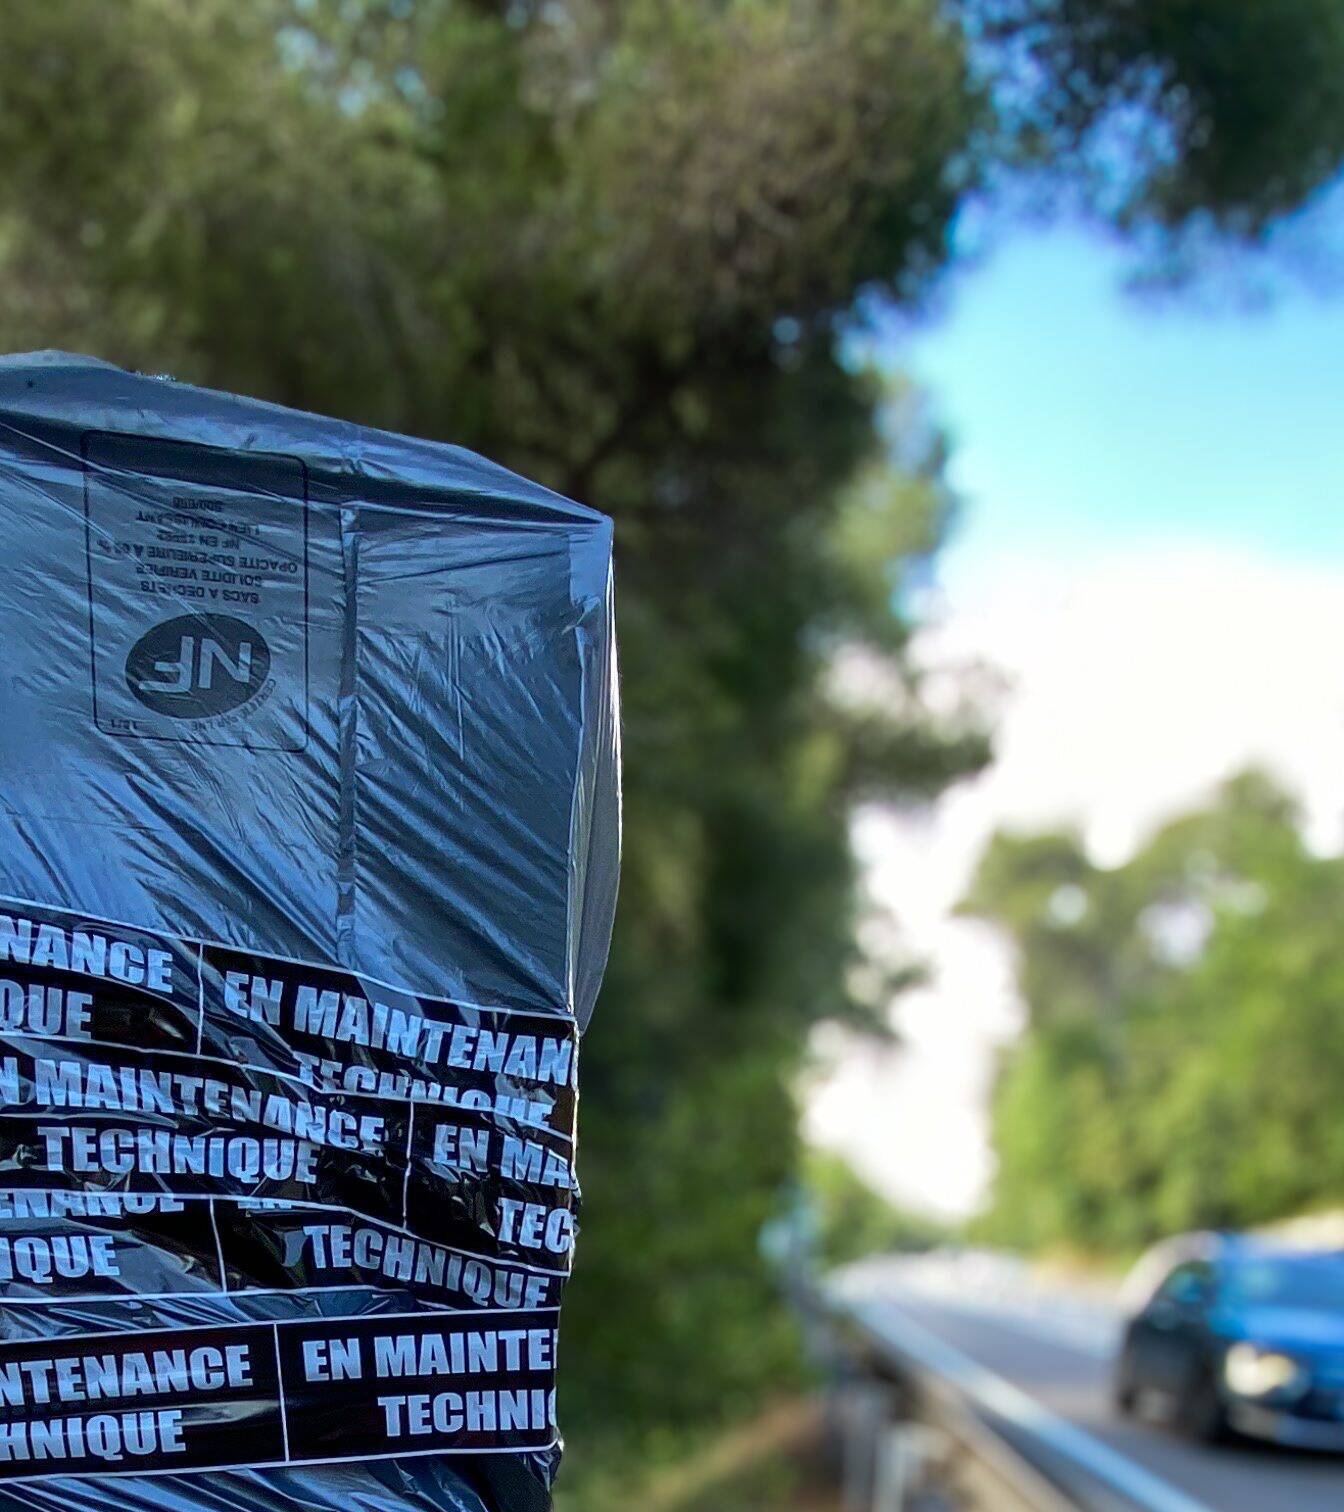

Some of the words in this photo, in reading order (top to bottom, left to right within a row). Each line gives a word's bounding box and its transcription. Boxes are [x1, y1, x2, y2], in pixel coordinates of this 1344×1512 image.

[202, 569, 263, 587] SOLIDITE
[239, 556, 298, 574] OPACITE
[209, 587, 220, 599] A
[222, 588, 260, 604] SACS
[138, 635, 252, 694] NF
[223, 969, 284, 1027] EN
[294, 984, 574, 1086] MAINTENAN
[35, 1058, 385, 1155] MAINTENANCE
[433, 1122, 490, 1174] EN
[36, 1124, 318, 1185] TECHNIQUE
[302, 1224, 550, 1310] TECHNIQUE
[302, 1338, 362, 1381] EN
[374, 1328, 557, 1378] MAINTE
[377, 1389, 556, 1438] TECHNI
